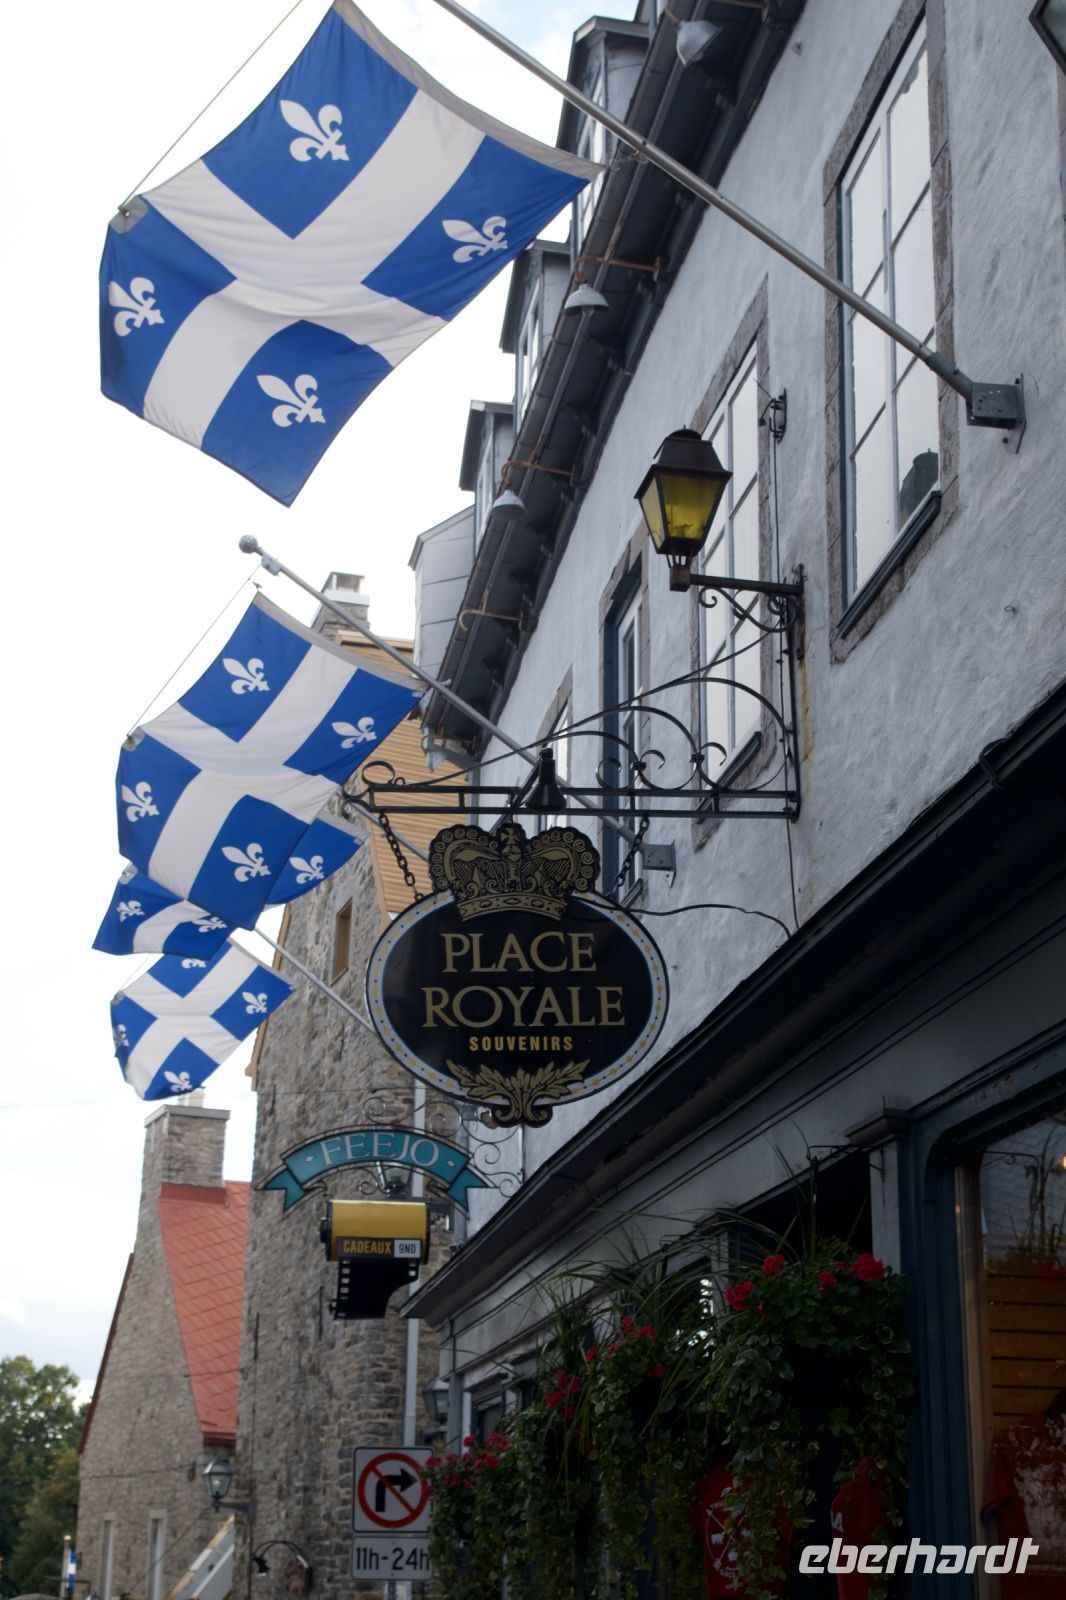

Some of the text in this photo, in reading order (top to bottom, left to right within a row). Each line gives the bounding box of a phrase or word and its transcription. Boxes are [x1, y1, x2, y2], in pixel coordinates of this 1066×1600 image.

[441, 932, 597, 973] PLACE
[421, 985, 625, 1028] ROYALE
[469, 1036, 573, 1051] SOUVENIRS
[320, 1132, 439, 1167] FEEJO
[343, 1240, 391, 1254] CADEAUX
